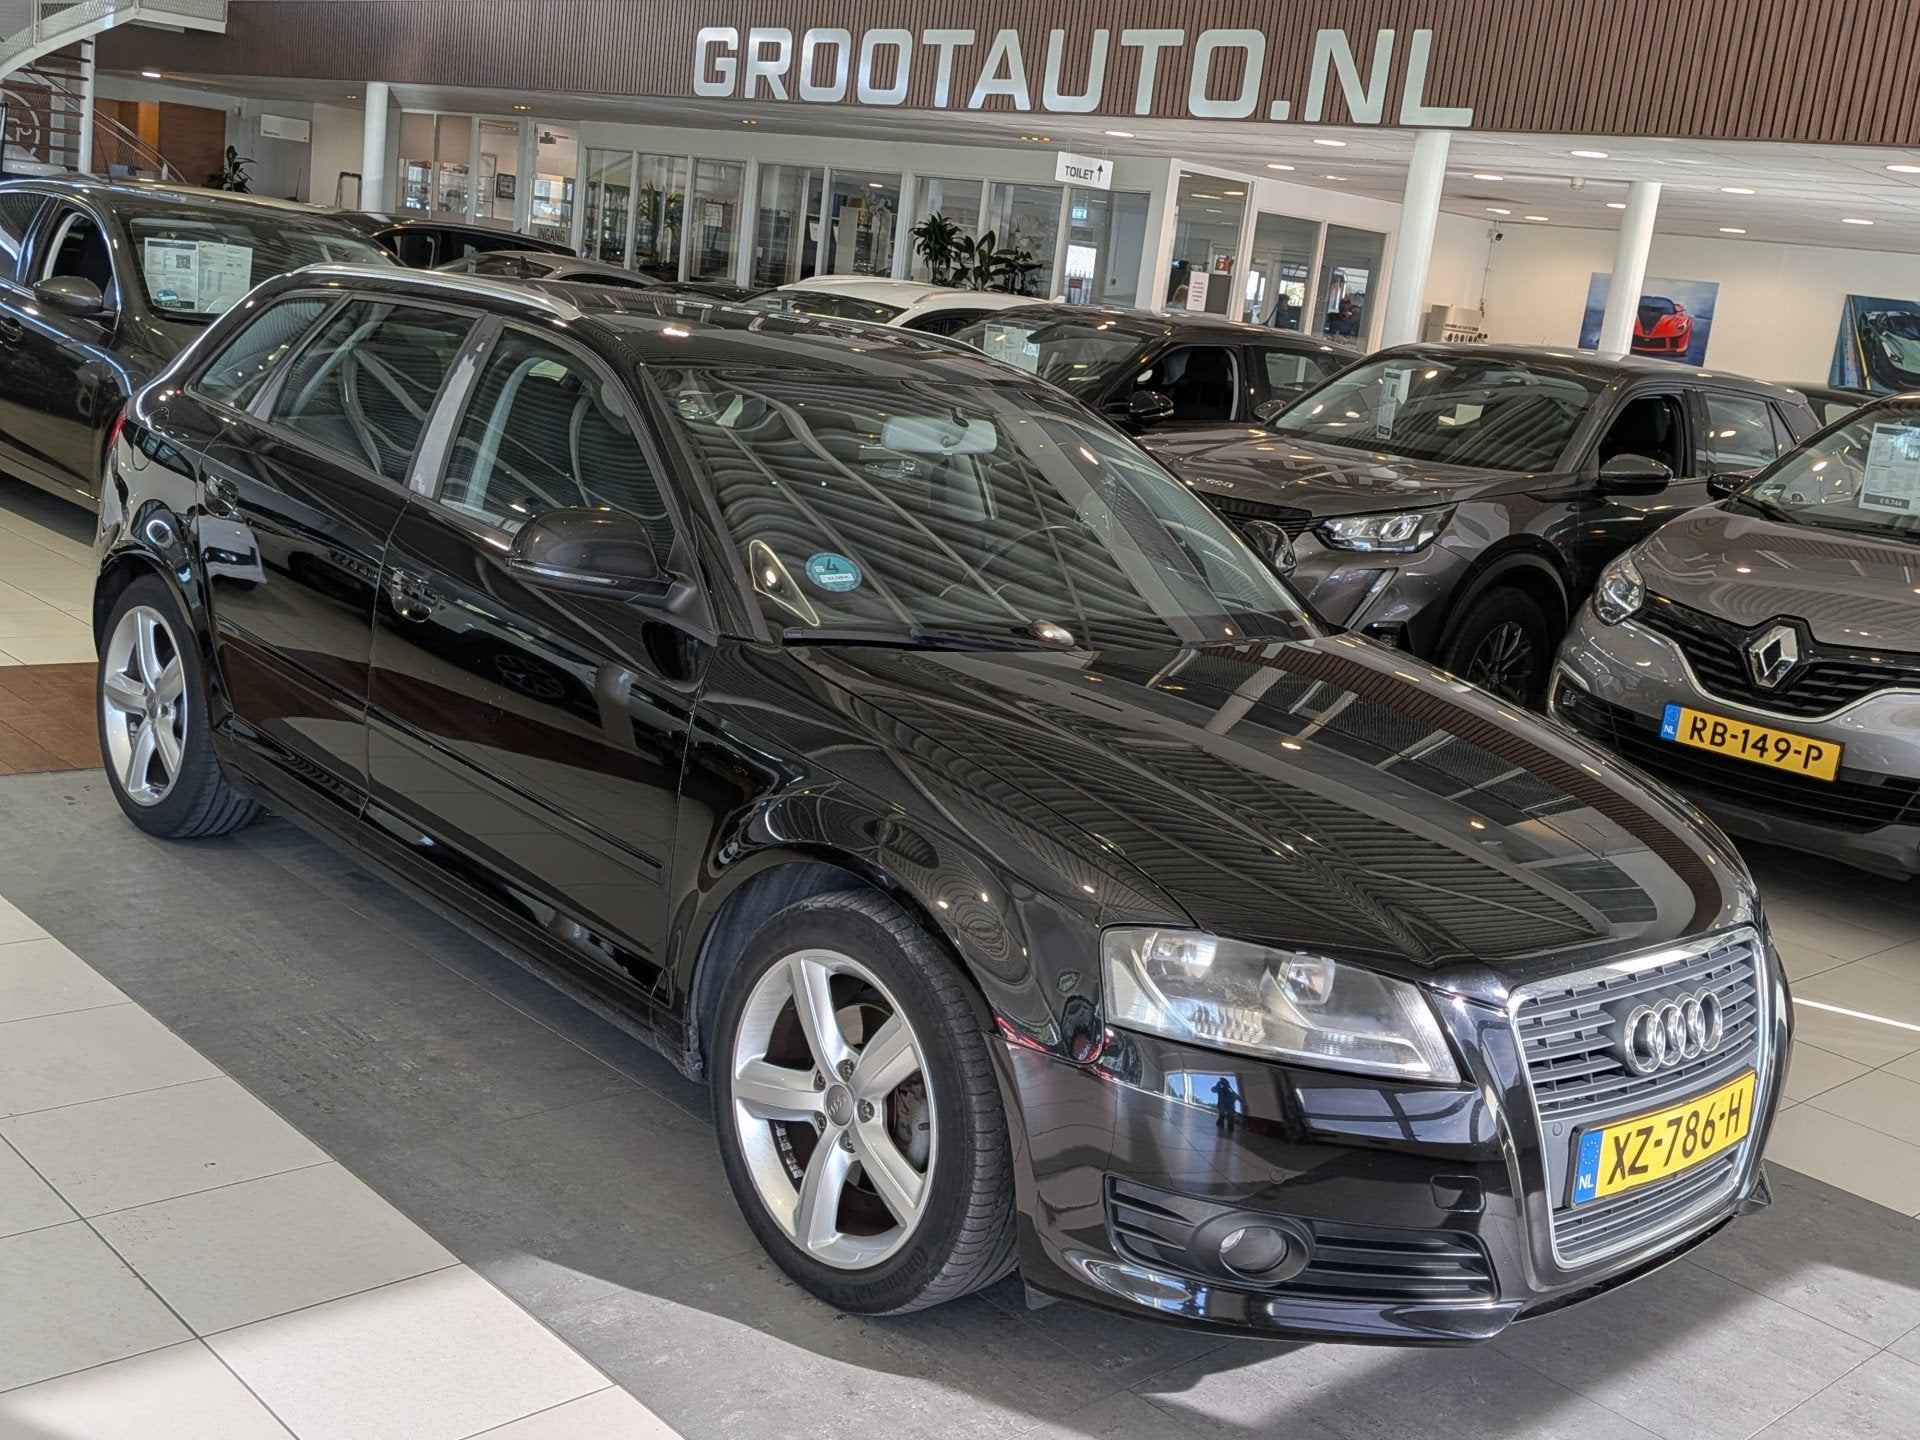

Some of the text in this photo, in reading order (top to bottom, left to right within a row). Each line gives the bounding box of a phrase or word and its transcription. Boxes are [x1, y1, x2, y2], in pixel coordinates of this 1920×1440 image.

[693, 27, 1474, 128] GROOTAUTO.NL
[1064, 165, 1095, 181] TOILET
[537, 227, 566, 243] INGANG
[826, 557, 840, 573] 4
[1663, 716, 1823, 769] NL RB-149-P
[1578, 1088, 1744, 1191] NL XZ-786-H
